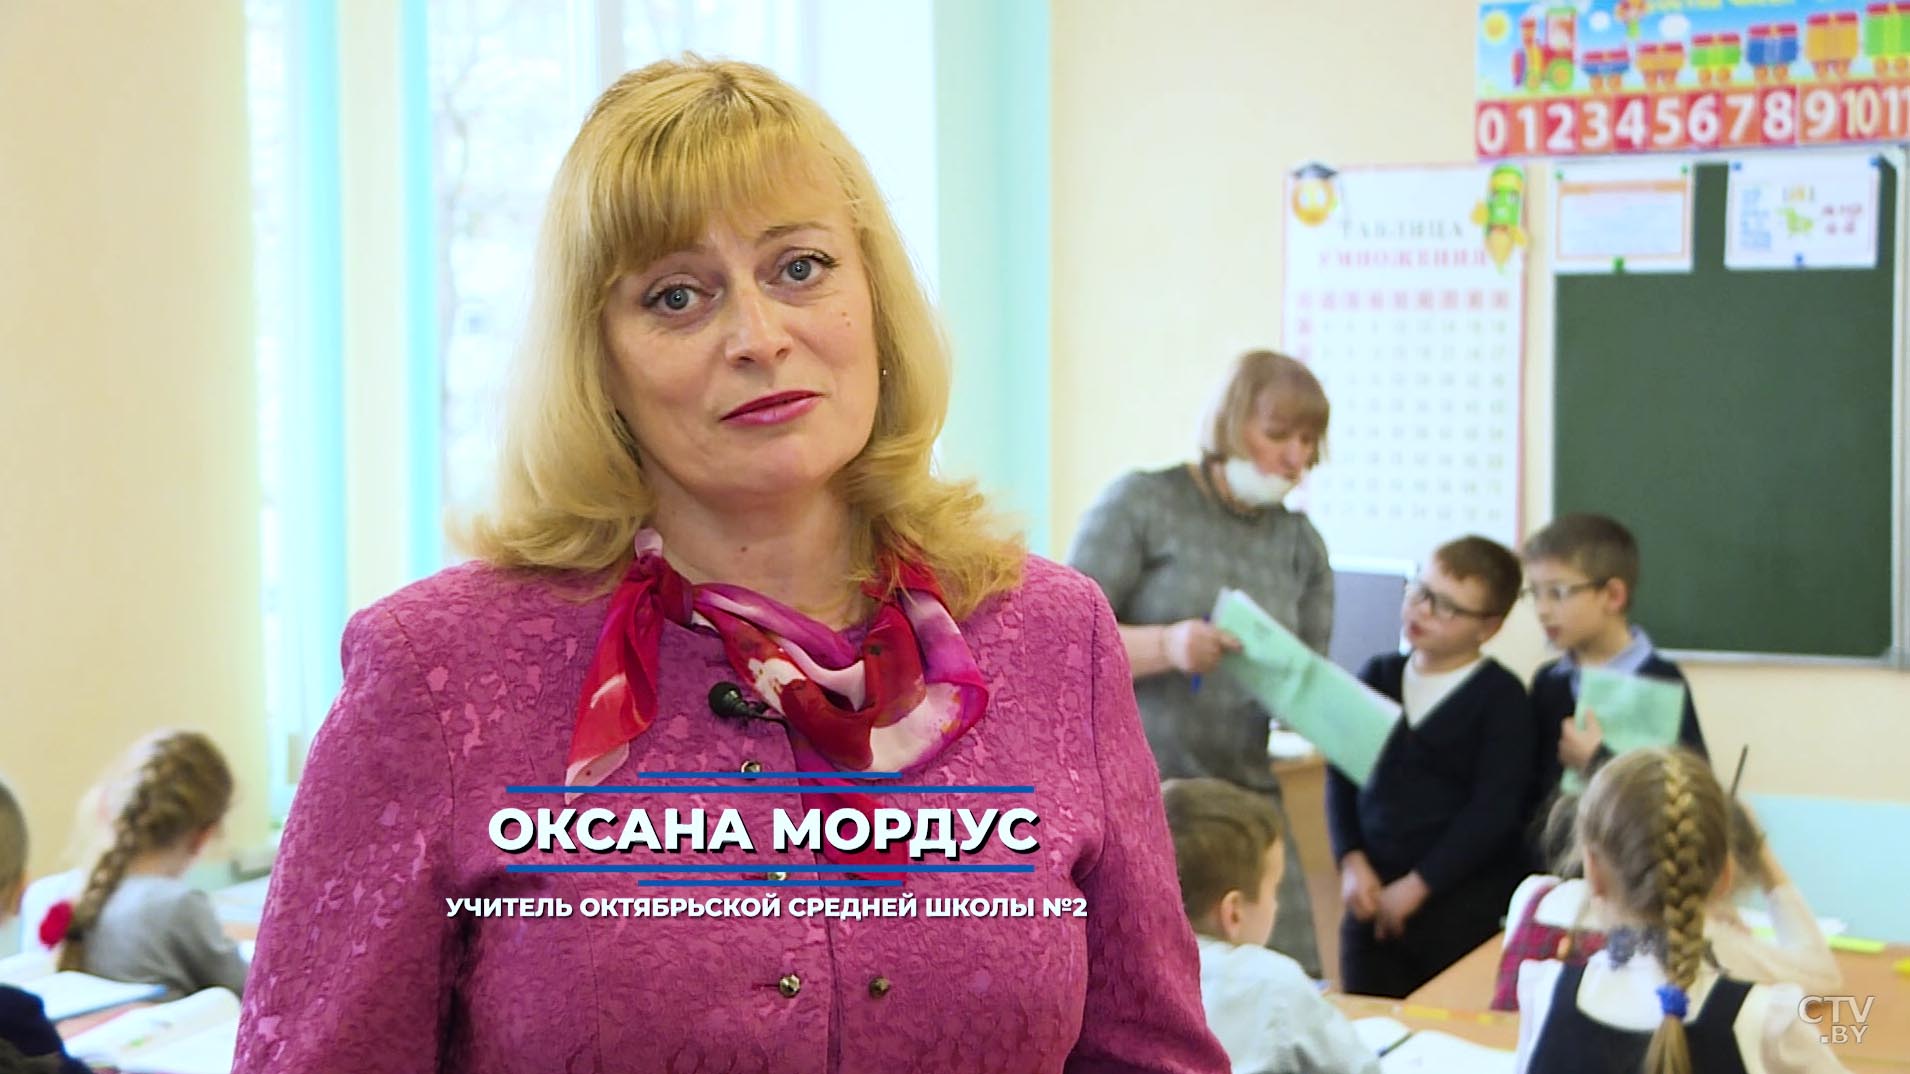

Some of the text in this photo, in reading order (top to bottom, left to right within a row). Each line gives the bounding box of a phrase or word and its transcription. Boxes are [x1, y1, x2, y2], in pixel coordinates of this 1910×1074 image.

[1478, 86, 1910, 152] 0 1 2 3 4 5 6 7 8 9 10 1
